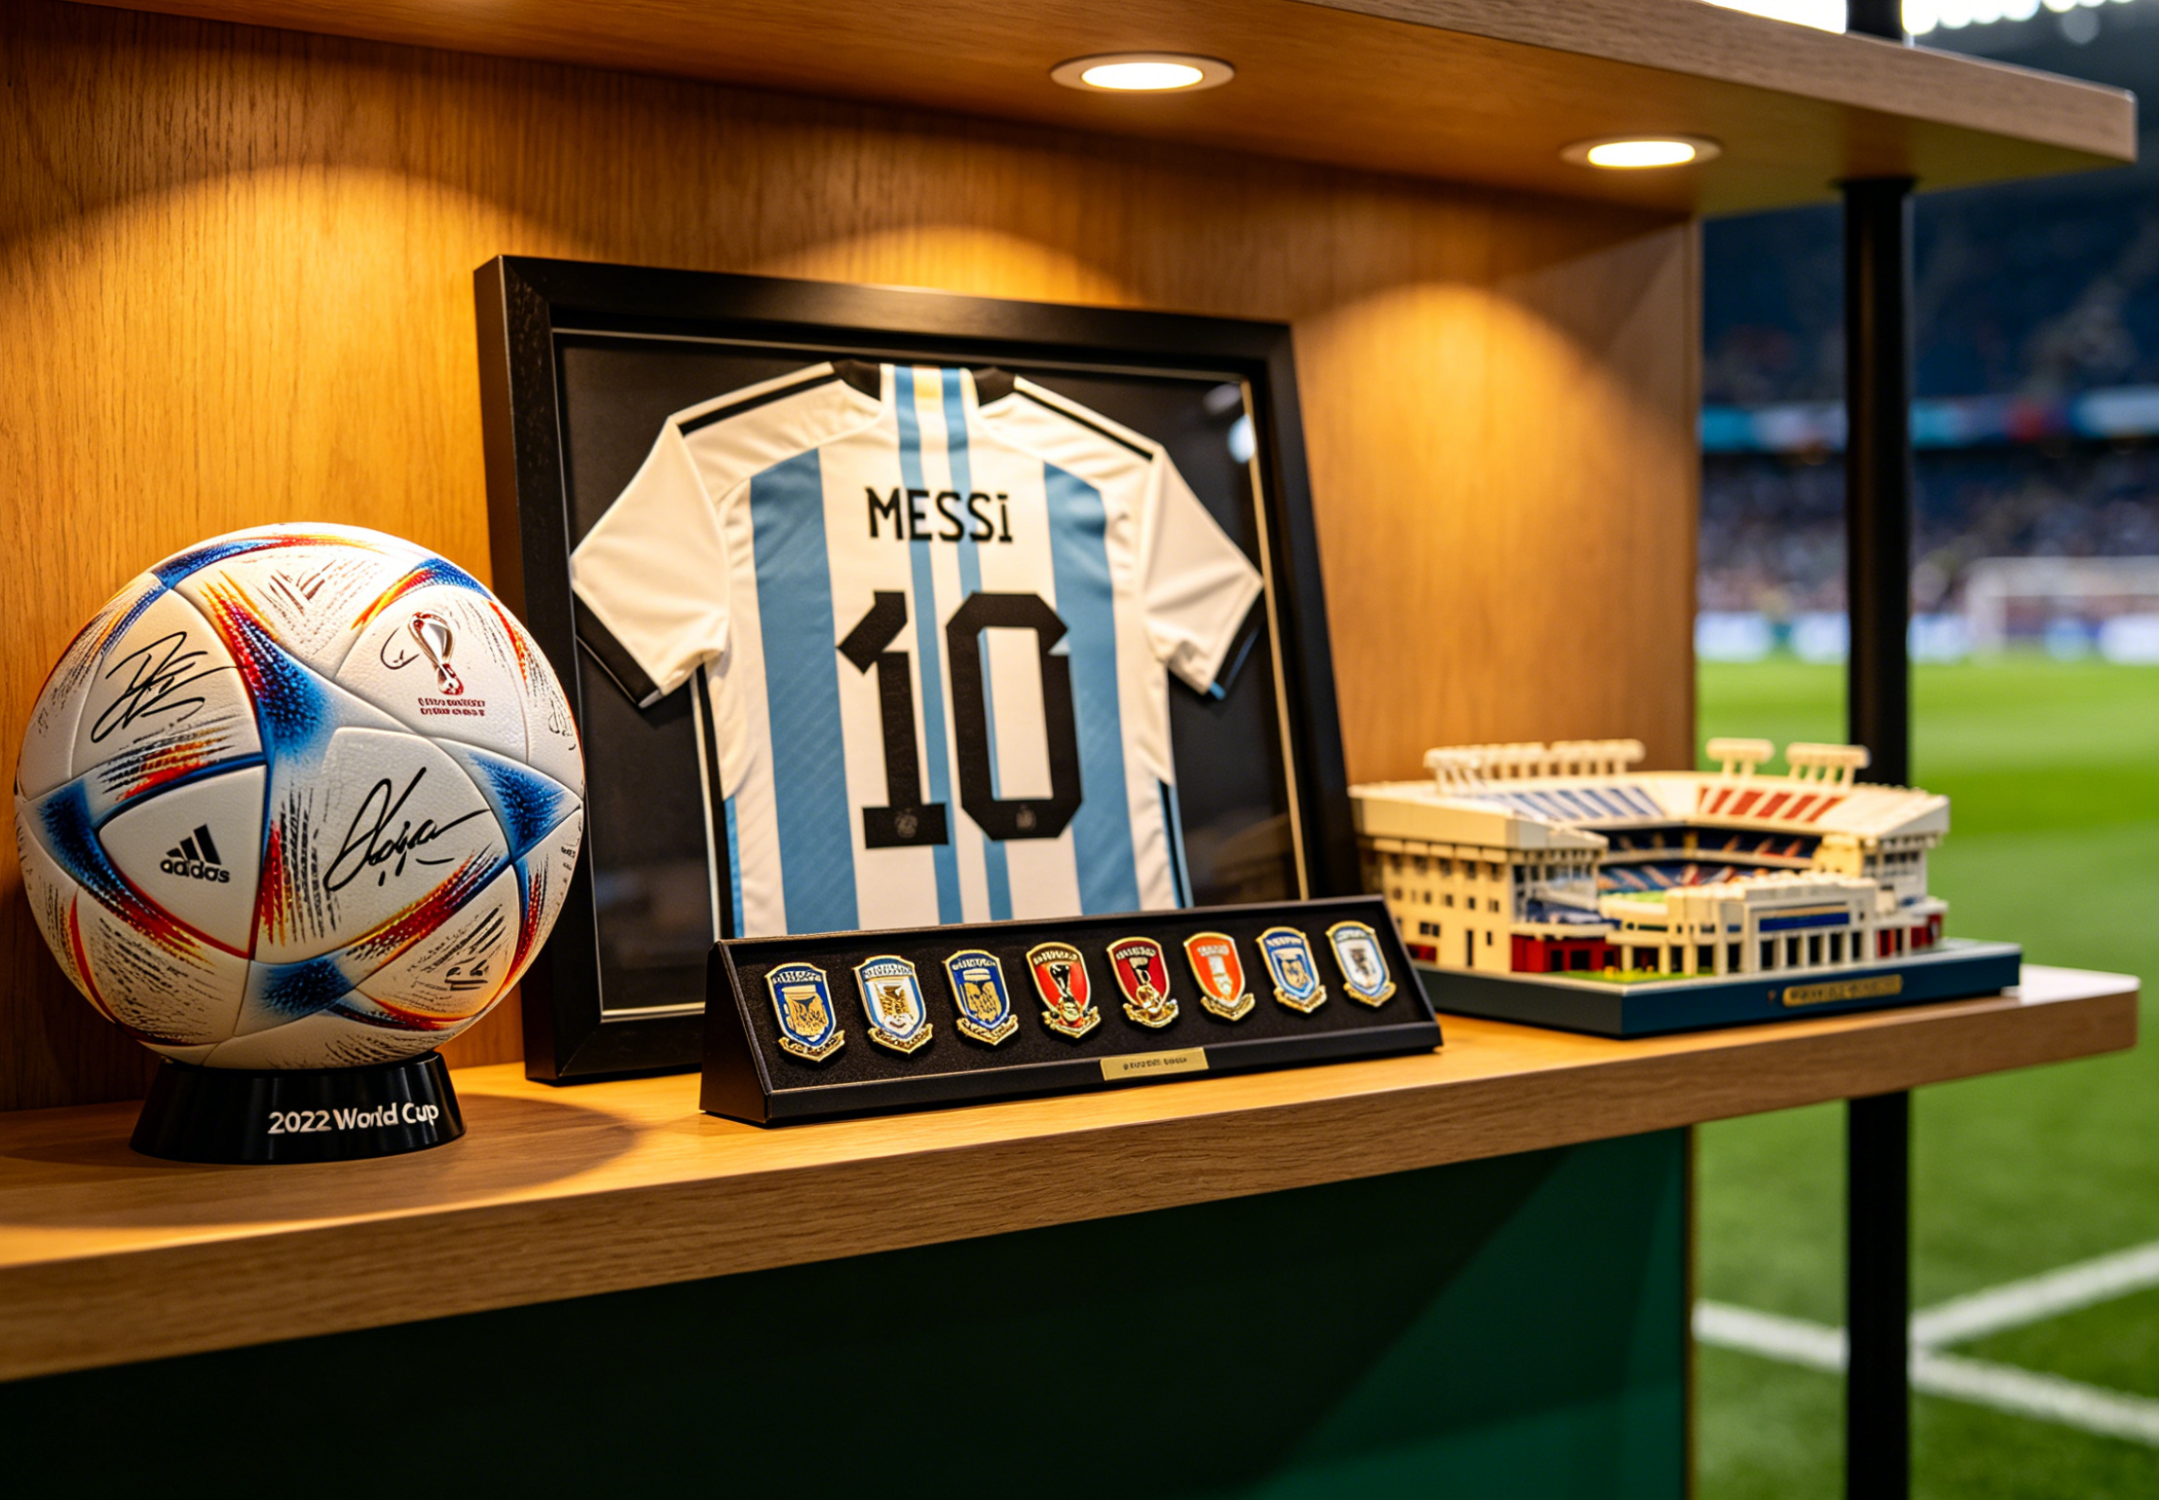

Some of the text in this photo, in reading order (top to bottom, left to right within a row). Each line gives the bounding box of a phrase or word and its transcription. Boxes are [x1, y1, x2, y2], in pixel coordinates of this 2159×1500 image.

[836, 590, 1083, 849] 10
[267, 1102, 439, 1134] 2022 World Cup
